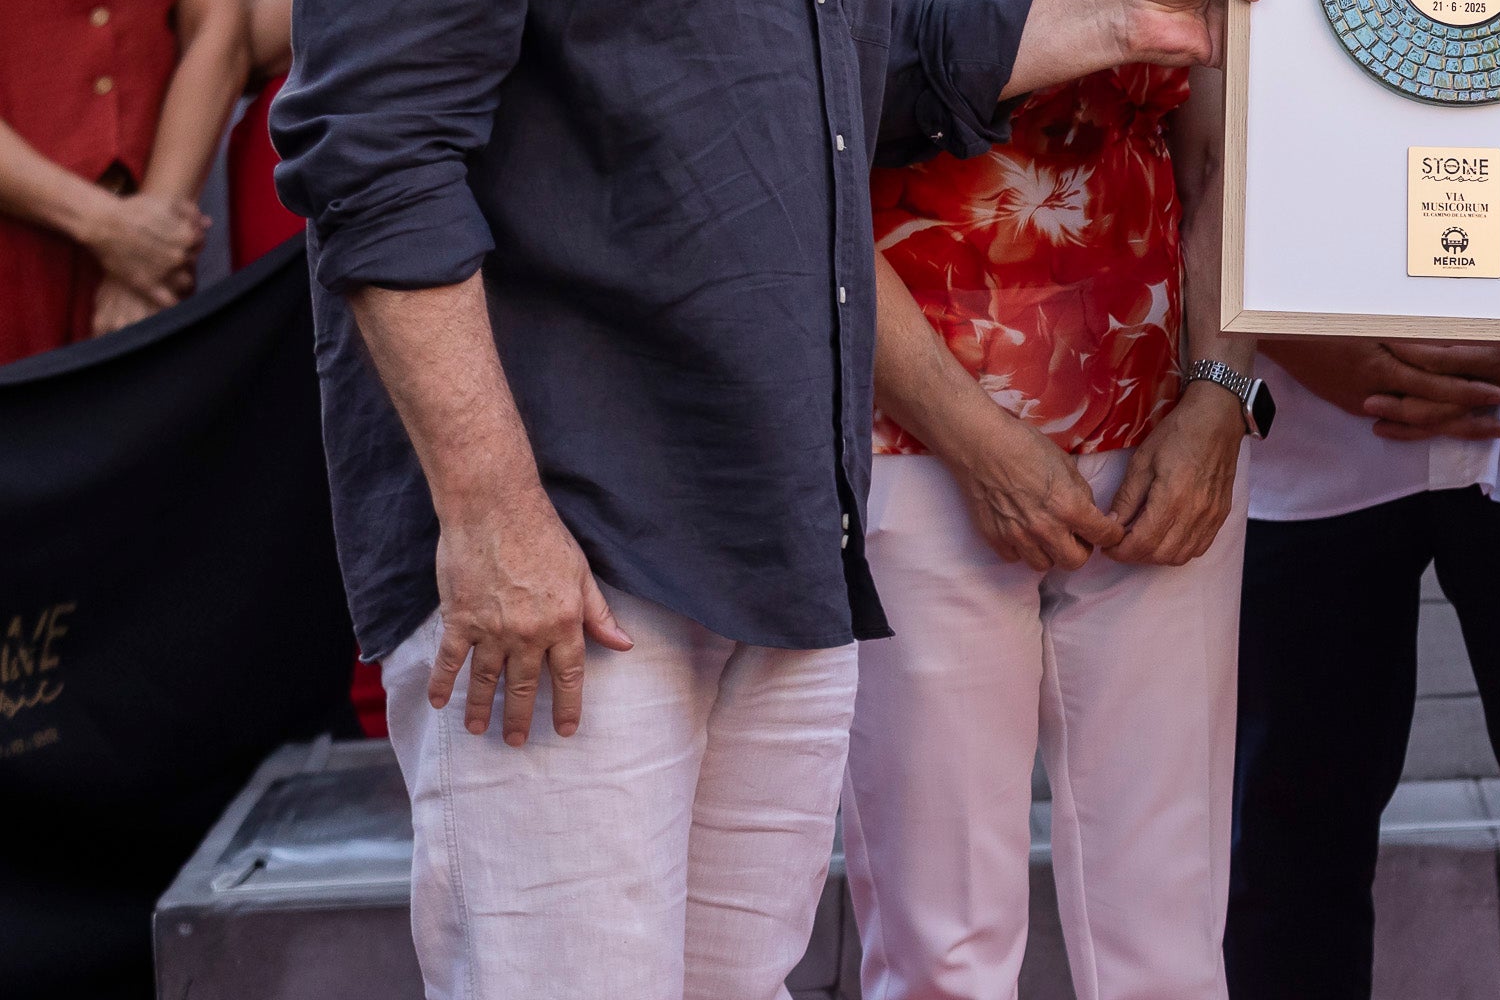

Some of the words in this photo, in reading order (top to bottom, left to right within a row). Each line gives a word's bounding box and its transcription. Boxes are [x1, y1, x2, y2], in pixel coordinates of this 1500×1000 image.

[1421, 157, 1489, 175] STONE
[1445, 192, 1465, 201] VIA
[1421, 202, 1489, 212] MUSICORUM
